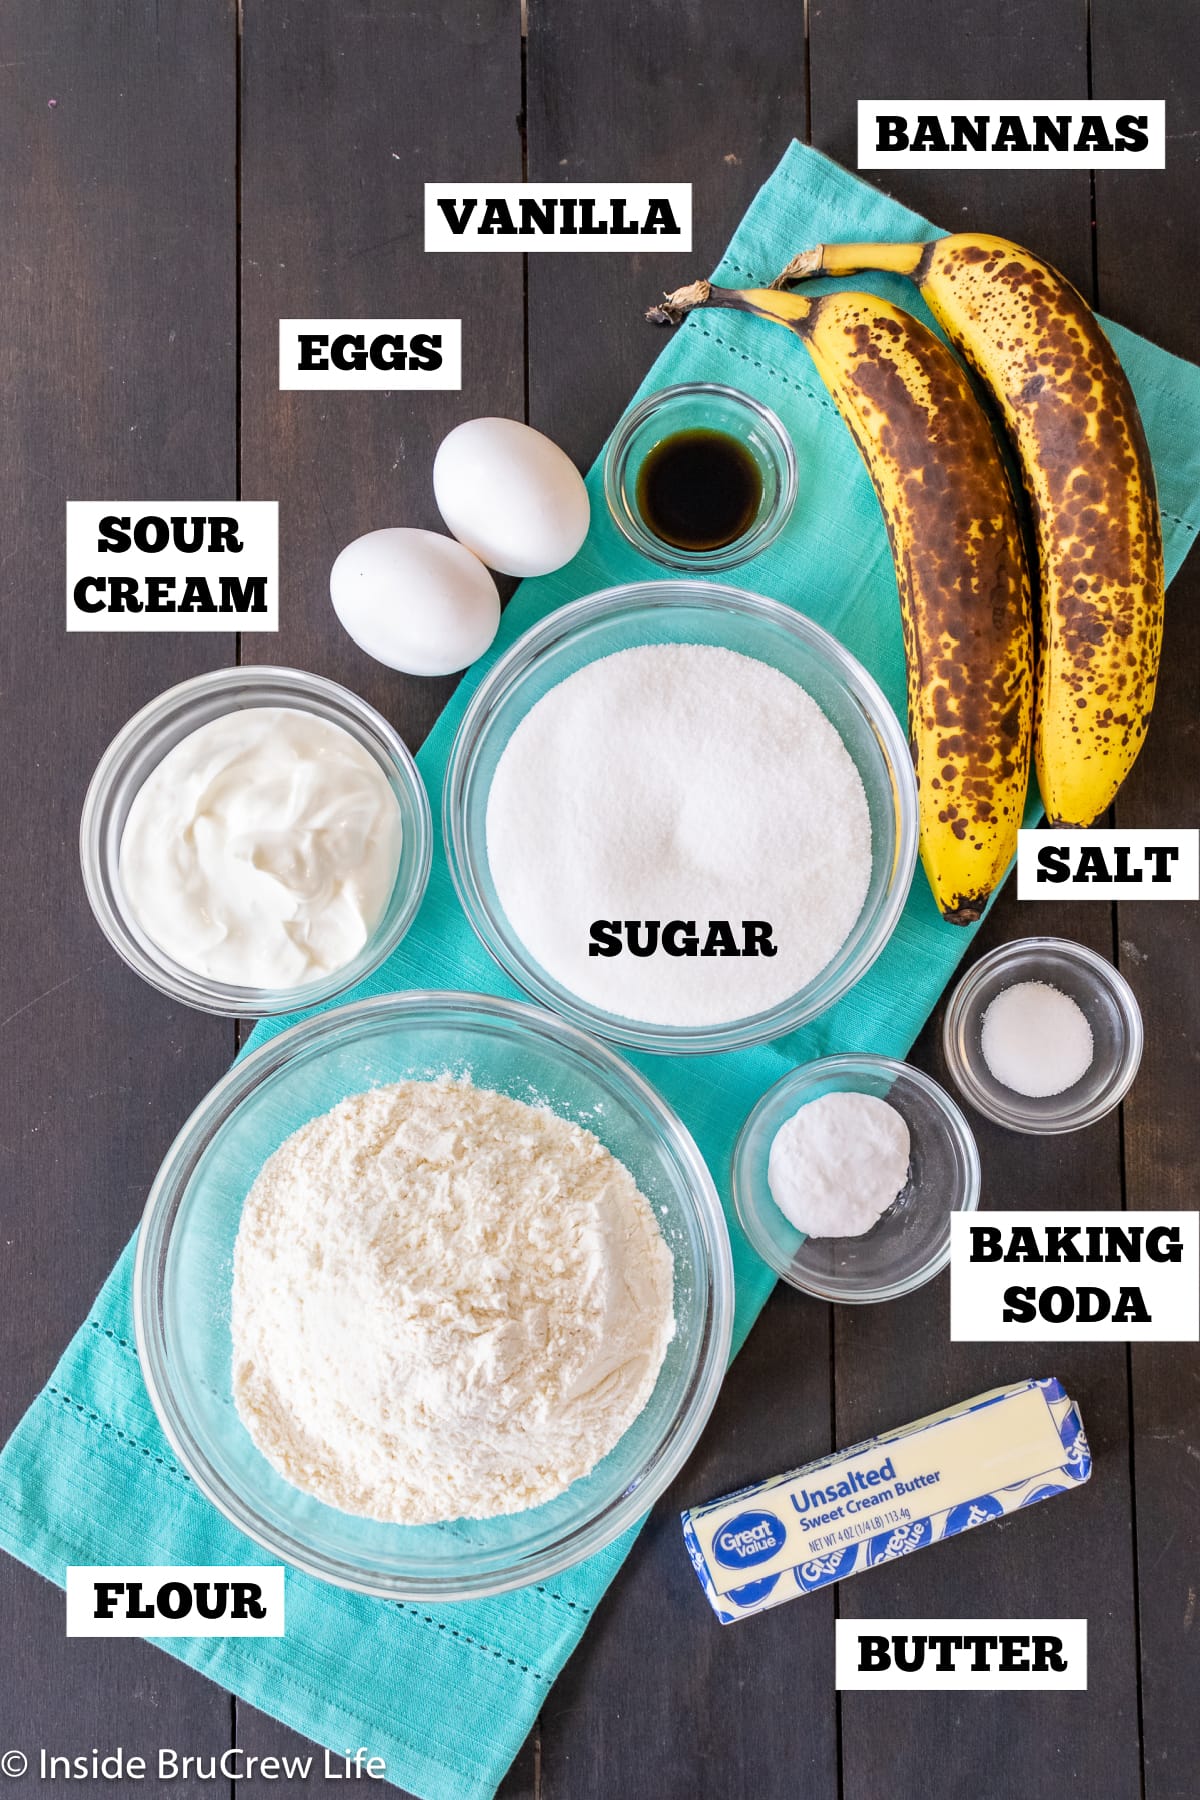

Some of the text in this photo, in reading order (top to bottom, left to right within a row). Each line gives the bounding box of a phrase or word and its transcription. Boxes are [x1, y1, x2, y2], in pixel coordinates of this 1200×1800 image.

[791, 1457, 896, 1513] Unsalted
[800, 1471, 940, 1531] Sweet Cream Butter
[720, 1520, 773, 1551] Great
[735, 1536, 777, 1558] Value
[808, 1537, 823, 1553] NET
[823, 1531, 836, 1547] WT
[838, 1530, 844, 1543] 4
[844, 1526, 855, 1539] OZ
[884, 1507, 911, 1525] 113.4g
